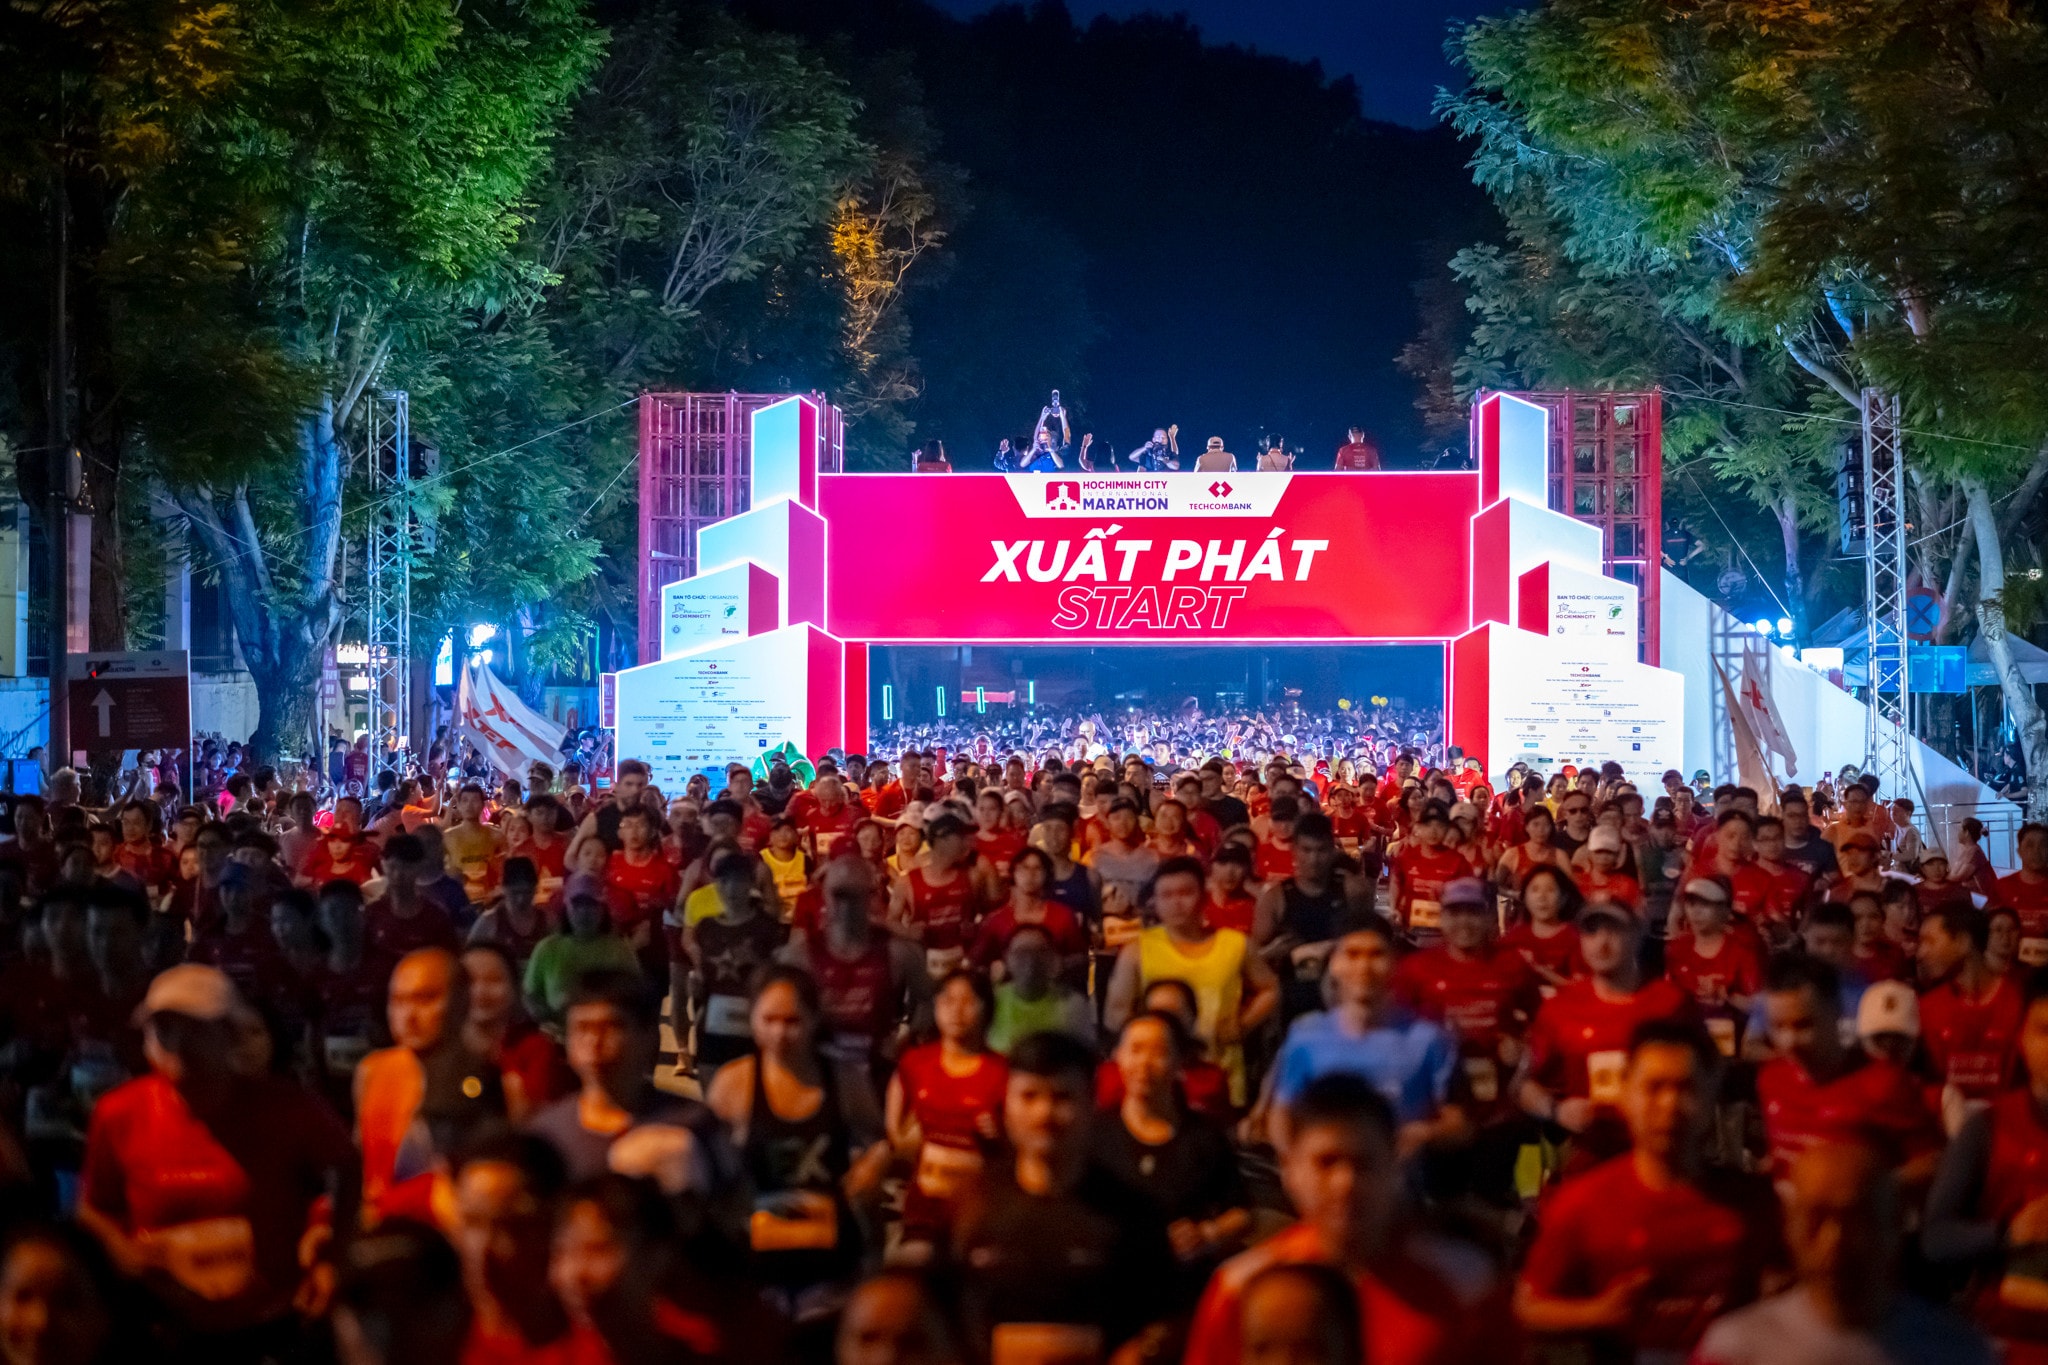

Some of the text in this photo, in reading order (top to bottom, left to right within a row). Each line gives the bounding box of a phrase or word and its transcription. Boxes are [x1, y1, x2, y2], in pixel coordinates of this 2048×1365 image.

[1083, 481, 1168, 489] HOCHIMINH CITY
[1083, 498, 1168, 510] MARATHON
[980, 523, 1329, 582] XUẤT PHÁT
[1051, 585, 1247, 630] START
